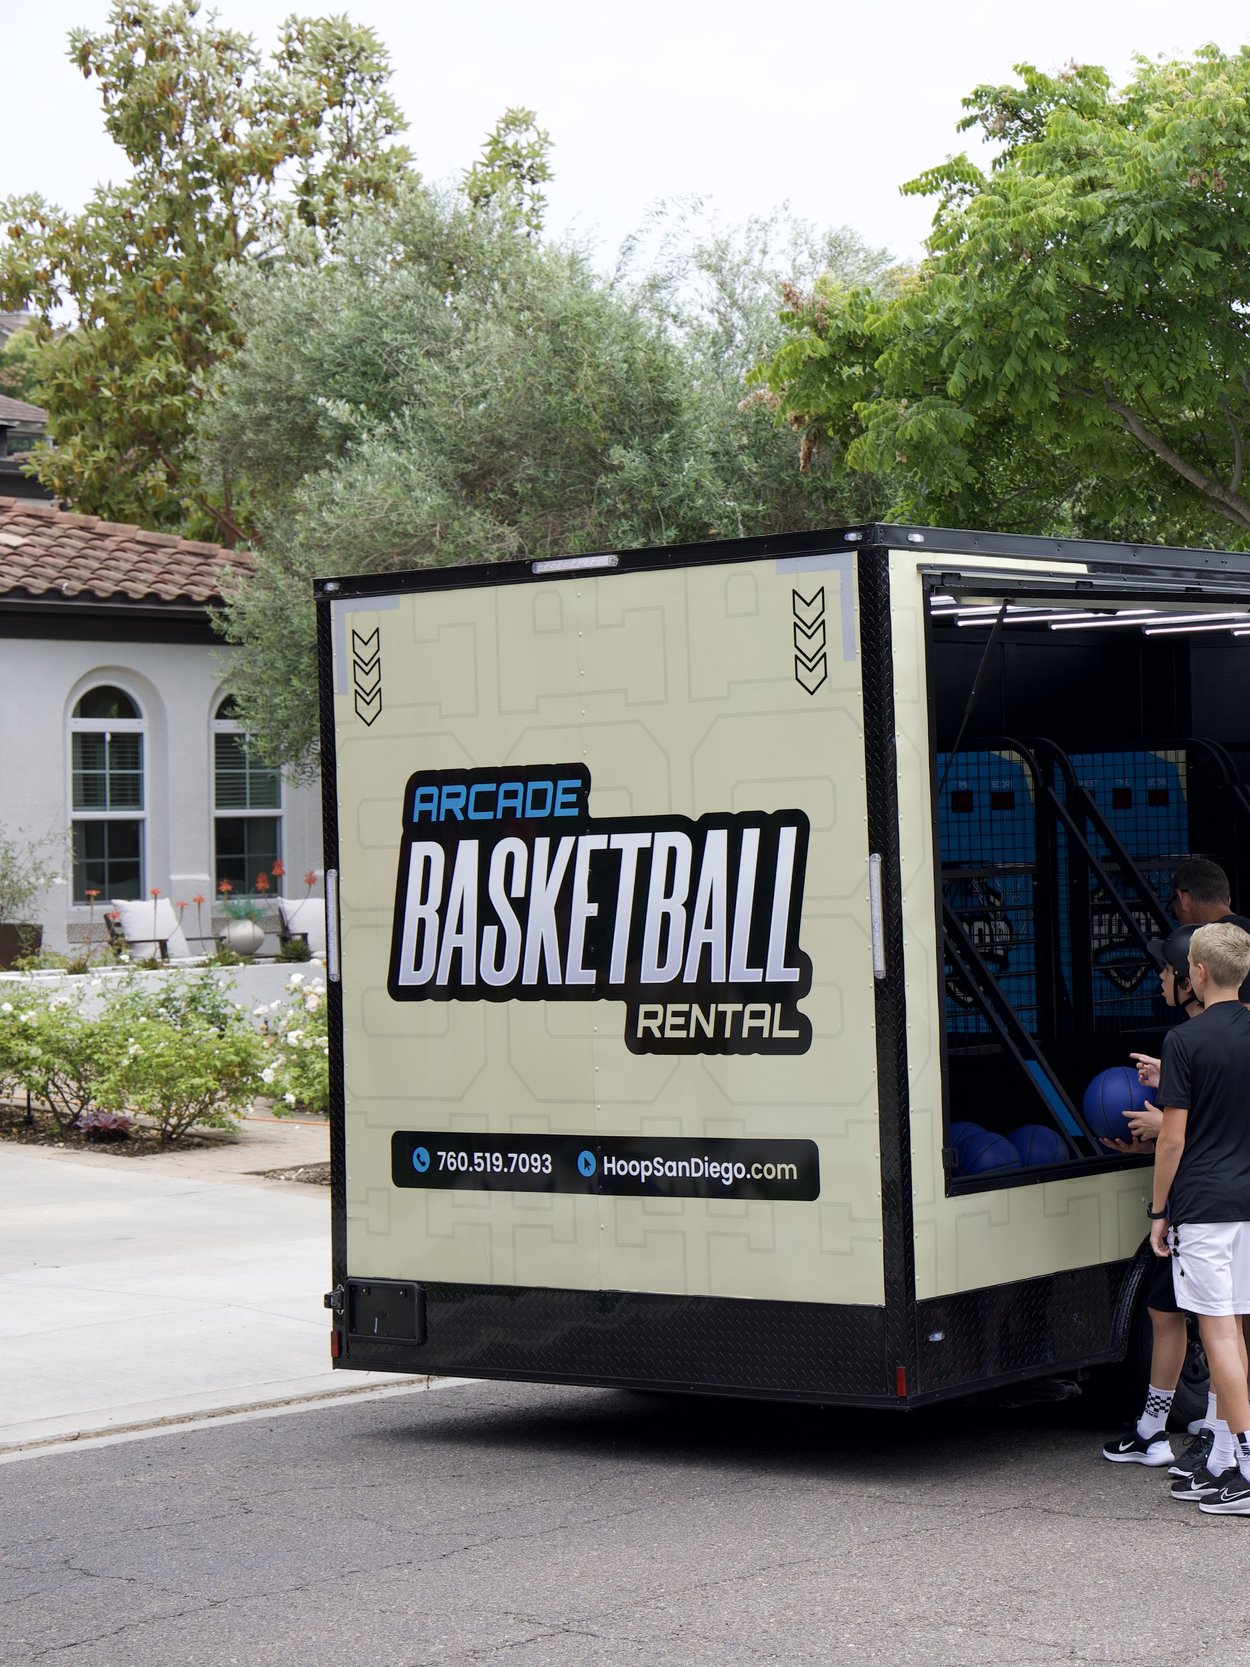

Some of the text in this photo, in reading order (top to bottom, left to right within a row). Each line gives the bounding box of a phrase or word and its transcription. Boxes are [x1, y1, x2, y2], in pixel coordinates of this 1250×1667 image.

[412, 779, 582, 822] ARCADE
[398, 826, 801, 987] BASKETBALL
[636, 1003, 800, 1039] RENTAL
[437, 1150, 798, 1186] 760.519.7093 HoopSanDiego.com
